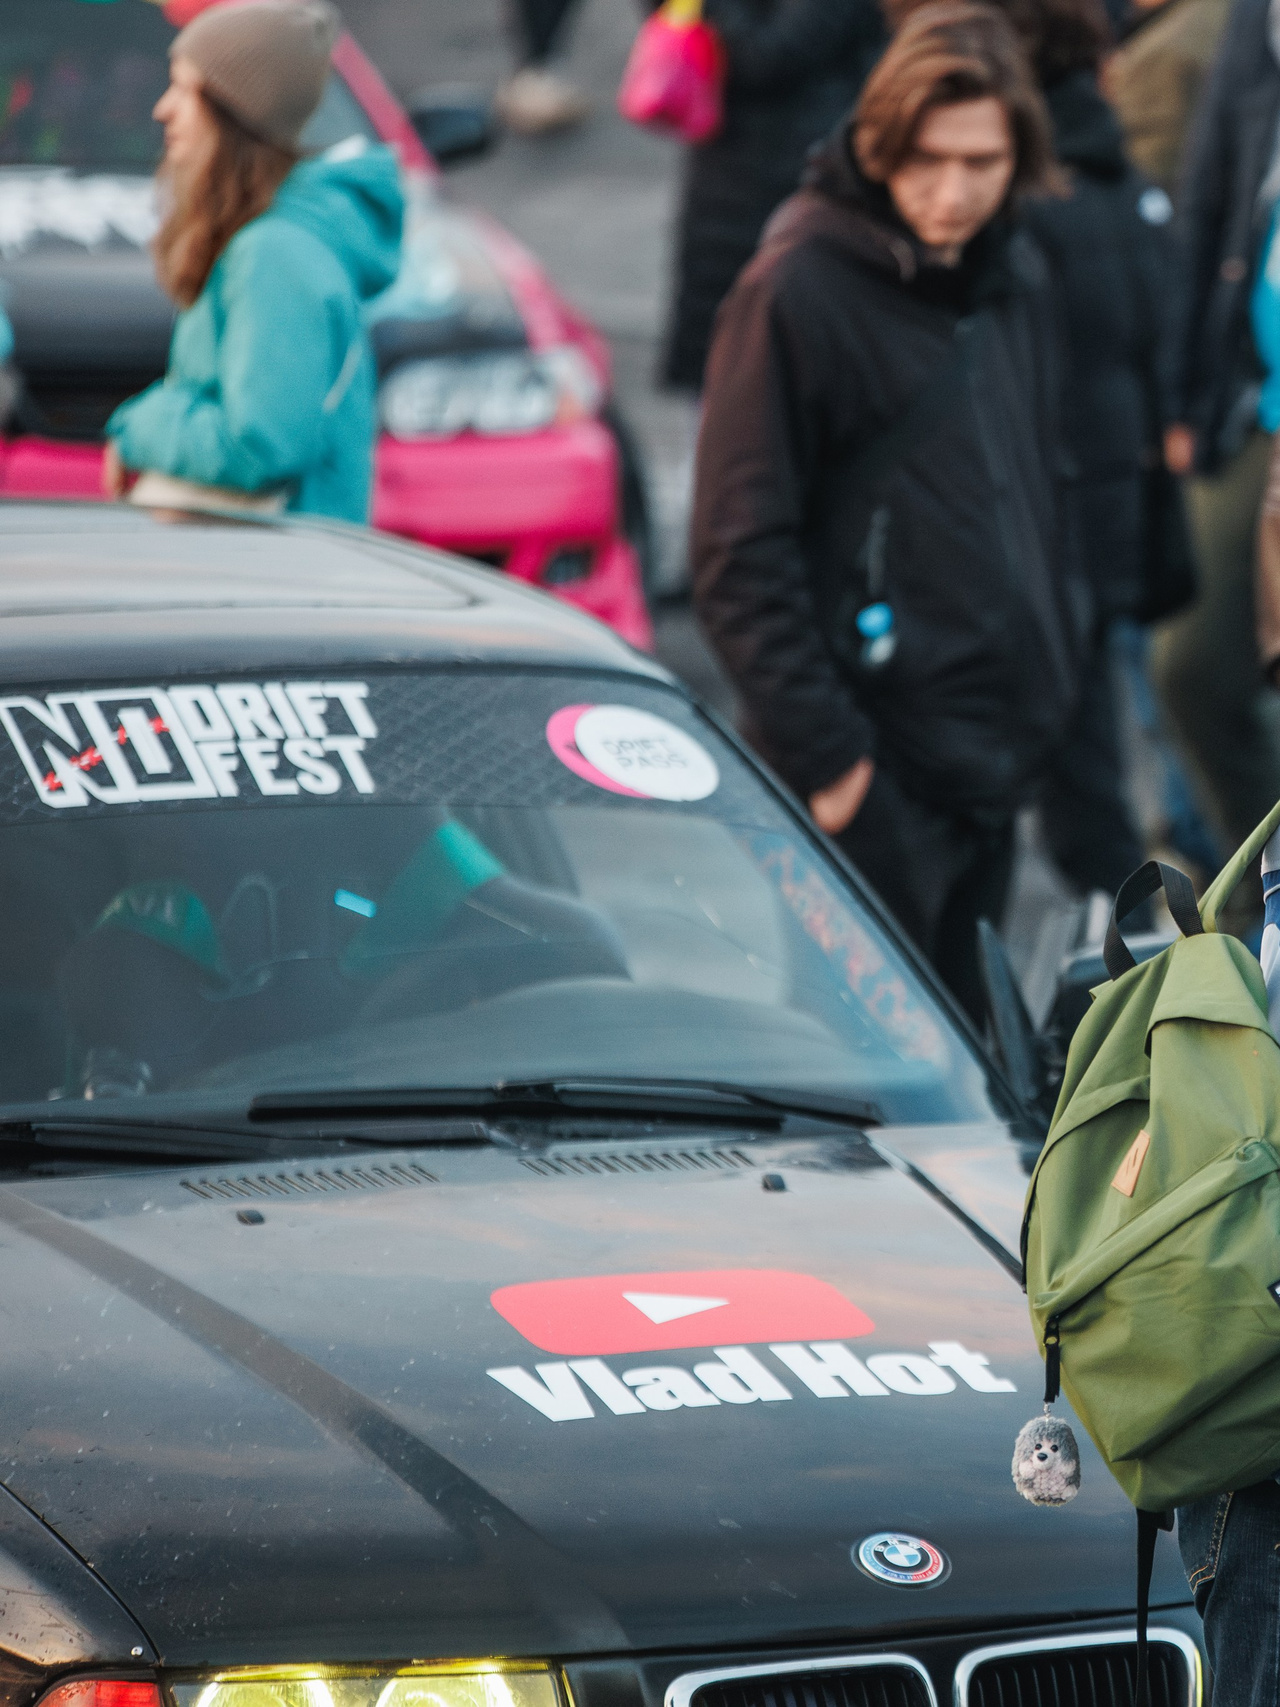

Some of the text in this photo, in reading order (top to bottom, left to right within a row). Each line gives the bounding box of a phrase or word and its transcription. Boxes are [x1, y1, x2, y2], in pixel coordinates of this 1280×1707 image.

[167, 682, 377, 740] DRIFT
[199, 737, 375, 797] FEST
[486, 1341, 1017, 1422] Vlad Hot
[874, 1539, 921, 1553] BMW
